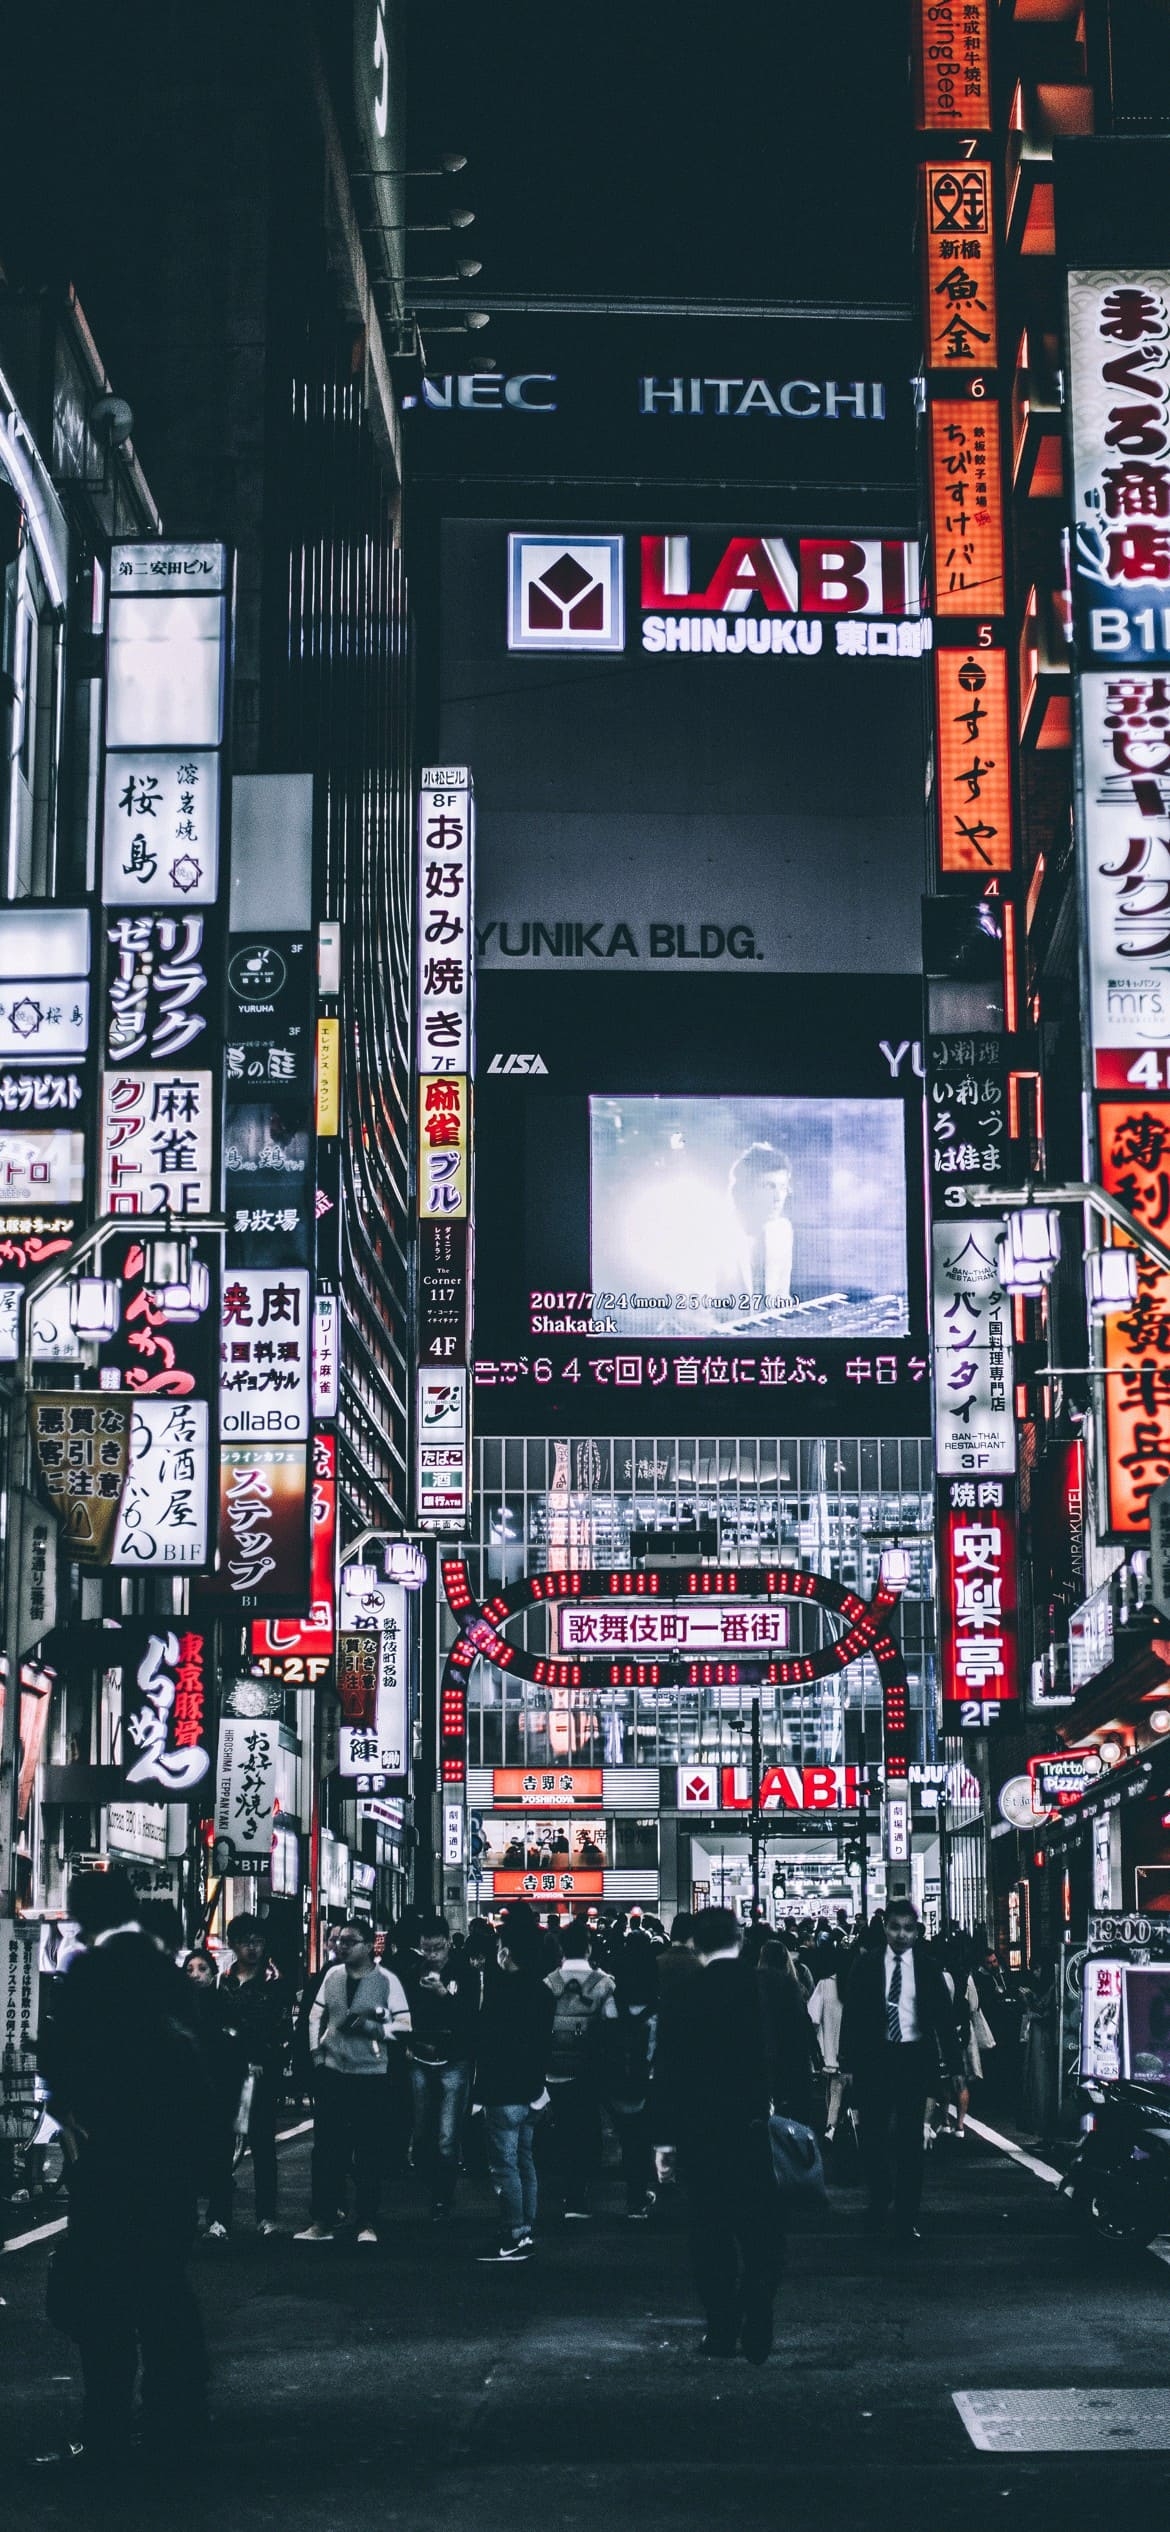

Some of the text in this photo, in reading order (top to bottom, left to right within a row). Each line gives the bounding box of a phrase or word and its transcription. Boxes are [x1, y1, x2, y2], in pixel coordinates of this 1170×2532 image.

[961, 140, 977, 158] 7
[939, 240, 981, 260] 新橋
[935, 266, 991, 358] 魚金
[641, 377, 886, 419] HITACHI
[971, 379, 985, 398] 6
[118, 560, 214, 577] 第二安田ビル
[640, 534, 922, 615] LABI
[641, 617, 824, 655] SHINJUKU
[978, 625, 993, 648] 5
[424, 769, 466, 786] 小松ビル
[433, 794, 457, 808] 8F
[119, 775, 164, 884] 桜島
[424, 814, 464, 1048] お好み焼き
[239, 1005, 274, 1013] YURUHA
[289, 1027, 301, 1035] 3F
[432, 1056, 456, 1071] 7F
[487, 1053, 549, 1074] LISA
[150, 1078, 201, 1174] 麻雀
[424, 1276, 462, 1285] Corner
[430, 1289, 455, 1301] 117
[531, 1316, 618, 1334] Shakatak
[429, 1336, 457, 1356] 4F
[988, 1291, 1006, 1413] タイ国料理専門店
[943, 1291, 982, 1424] バンタイ
[945, 1441, 1006, 1450] RESTAURANT
[951, 1432, 1000, 1441] BAN-THAI
[155, 1404, 198, 1527] 居酒屋
[423, 1451, 462, 1466] たばこ
[961, 1454, 990, 1469] 3F
[433, 1472, 452, 1487] 酒
[950, 1481, 1004, 1508] 焼肉
[226, 1468, 276, 1591] ステップ
[163, 1544, 201, 1561] B1F
[569, 1613, 780, 1643] 歌舞伎町一番街
[174, 1632, 205, 1748] 東京豚骨
[960, 1701, 1001, 1727] 2F
[219, 1730, 234, 1830] HIROSHIMA TEPPANYAKI
[235, 1730, 272, 1841] お好み焼き
[357, 1776, 386, 1792] 2F
[523, 1775, 574, 1791] 吉野家
[242, 1861, 270, 1872] B1F
[523, 1874, 574, 1890] 吉野家
